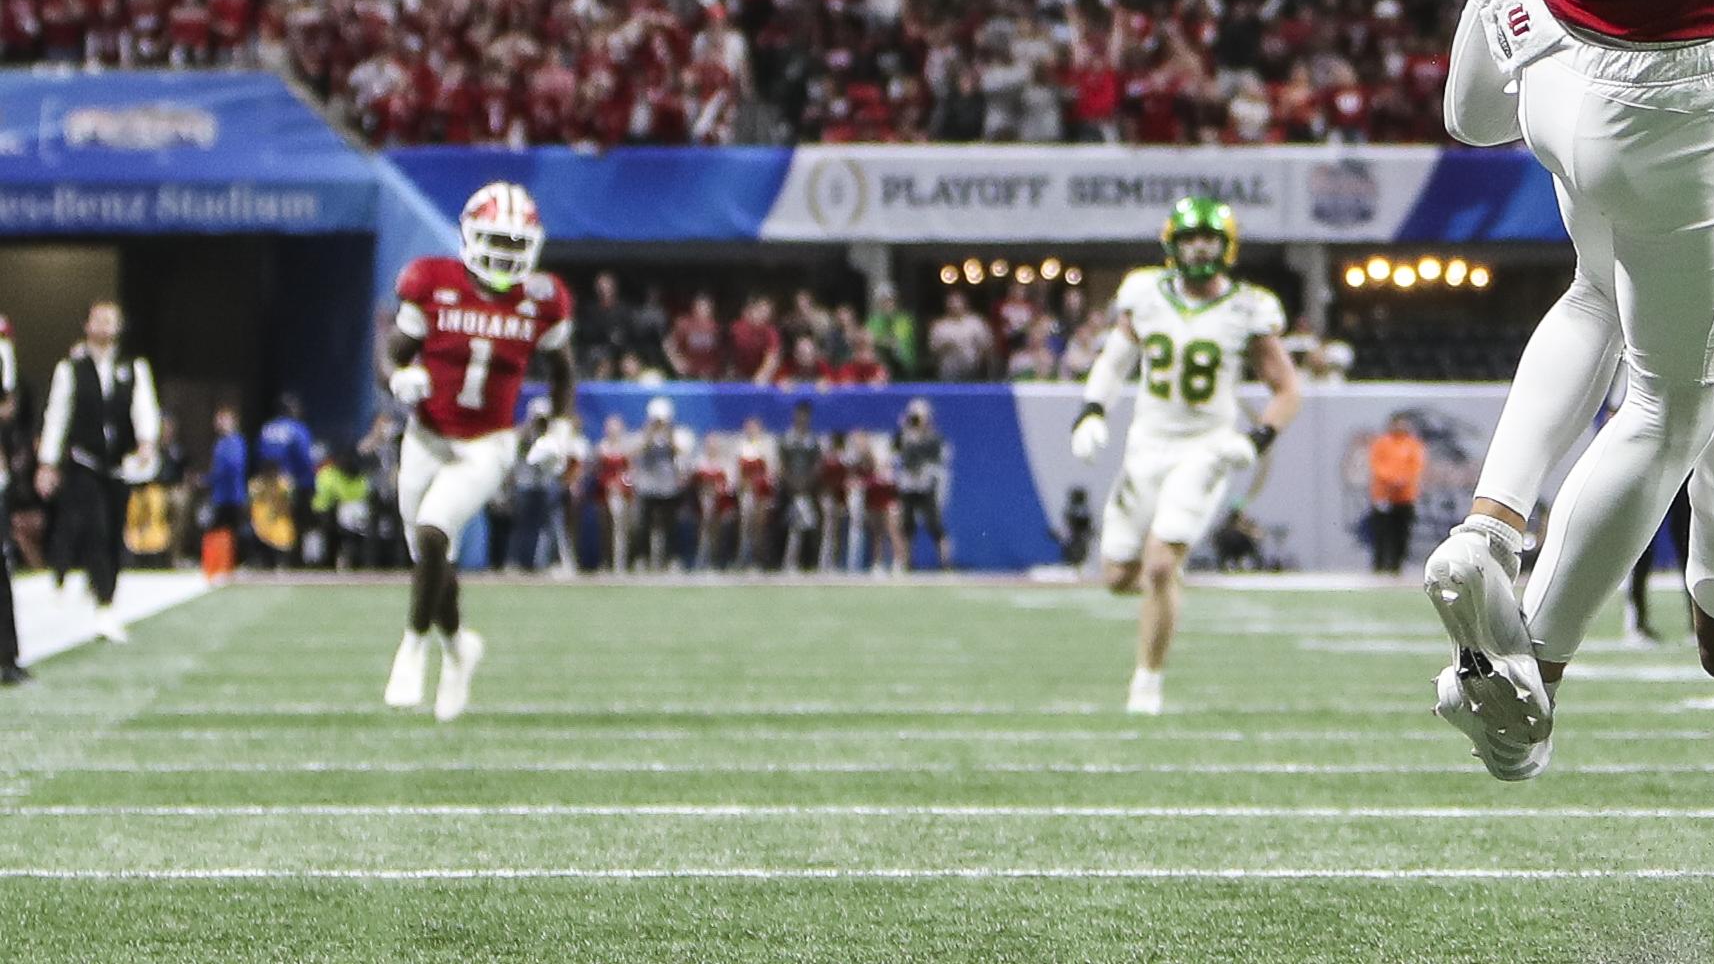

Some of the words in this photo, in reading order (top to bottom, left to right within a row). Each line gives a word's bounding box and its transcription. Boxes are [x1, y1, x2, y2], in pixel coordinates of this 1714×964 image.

[155, 185, 318, 224] Stadium
[880, 173, 1050, 208] PLAYOFF
[437, 307, 535, 343] INDIANA
[456, 338, 494, 410] 1
[1144, 331, 1222, 407] 28
